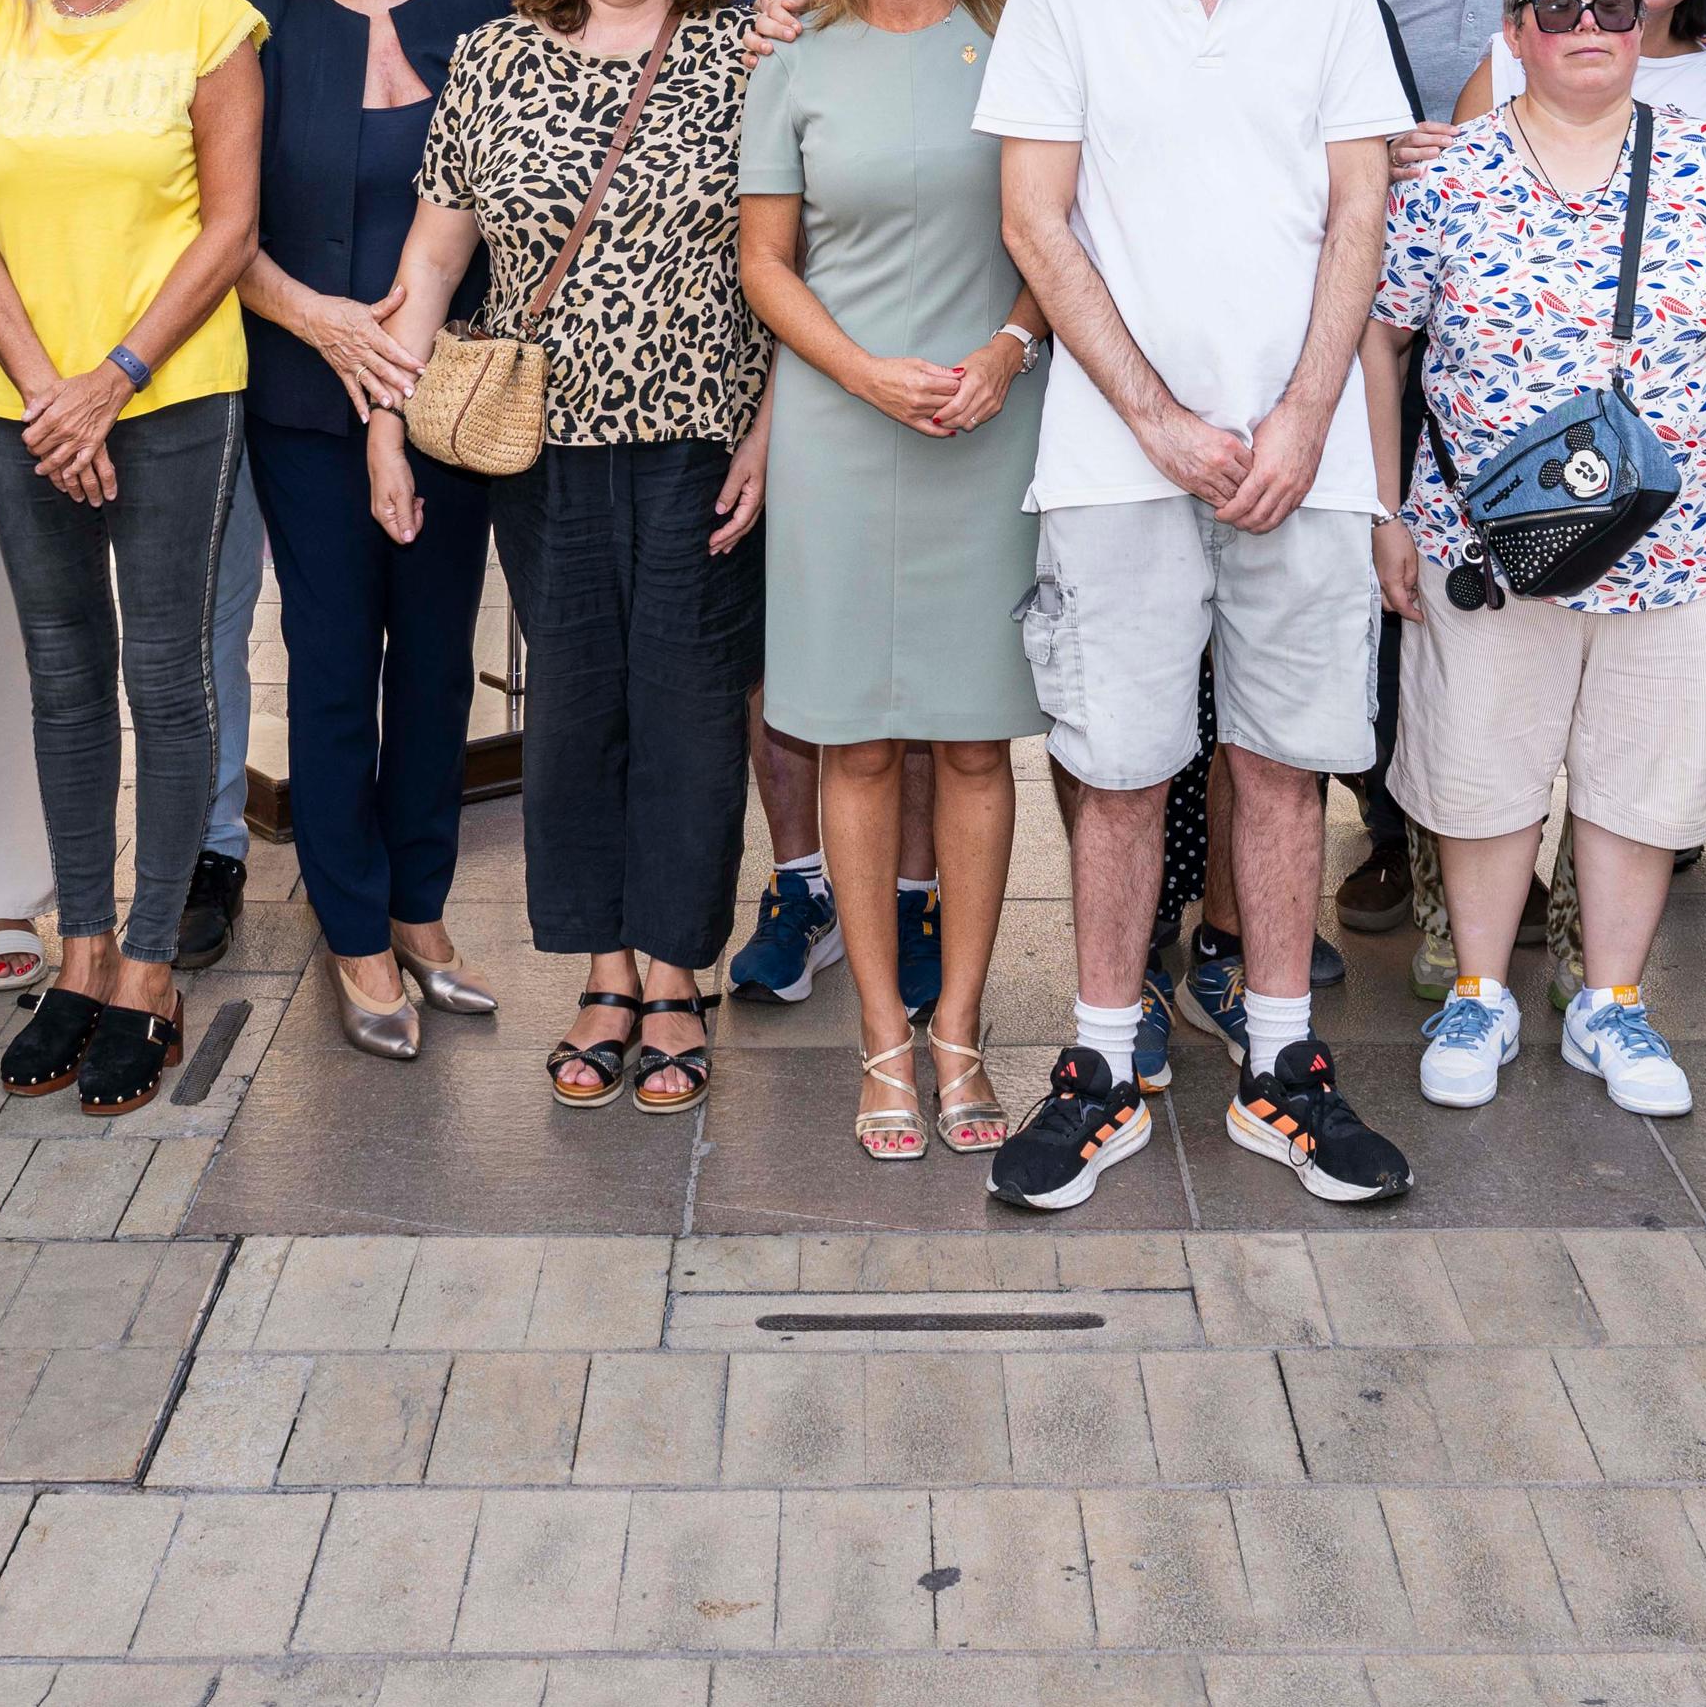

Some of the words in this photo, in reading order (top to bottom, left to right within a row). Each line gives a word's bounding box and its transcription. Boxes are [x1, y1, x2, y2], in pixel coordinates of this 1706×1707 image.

[1483, 474, 1524, 513] Desigual
[1458, 980, 1478, 996] nike
[1616, 989, 1637, 1003] nike
